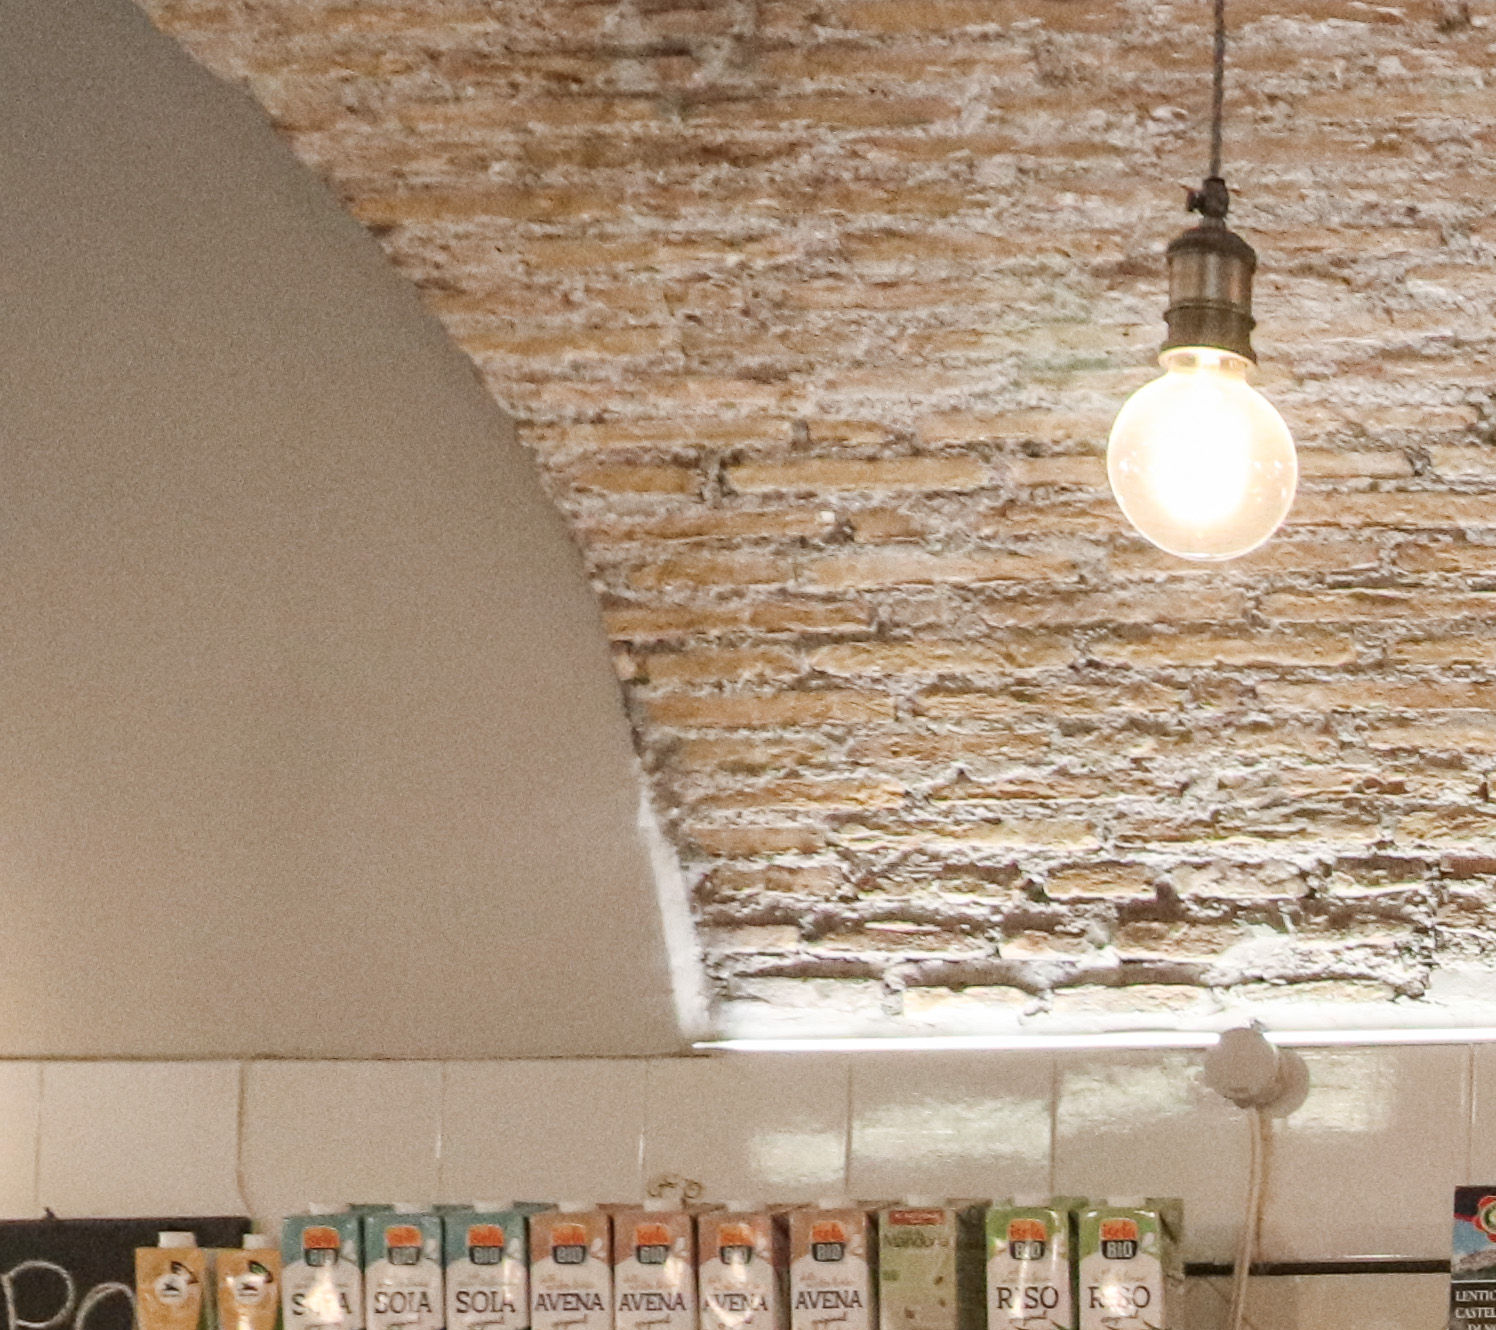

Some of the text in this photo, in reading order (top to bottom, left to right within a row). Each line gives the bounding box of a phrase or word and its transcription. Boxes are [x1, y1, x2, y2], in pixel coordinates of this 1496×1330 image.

[291, 1291, 352, 1316] SA
[373, 1291, 432, 1315] SOIA
[455, 1291, 516, 1315] SOIA
[535, 1293, 604, 1312] AVENA
[618, 1293, 687, 1312] AVENA
[795, 1290, 863, 1310] AVENA
[1090, 1286, 1152, 1310] RO
